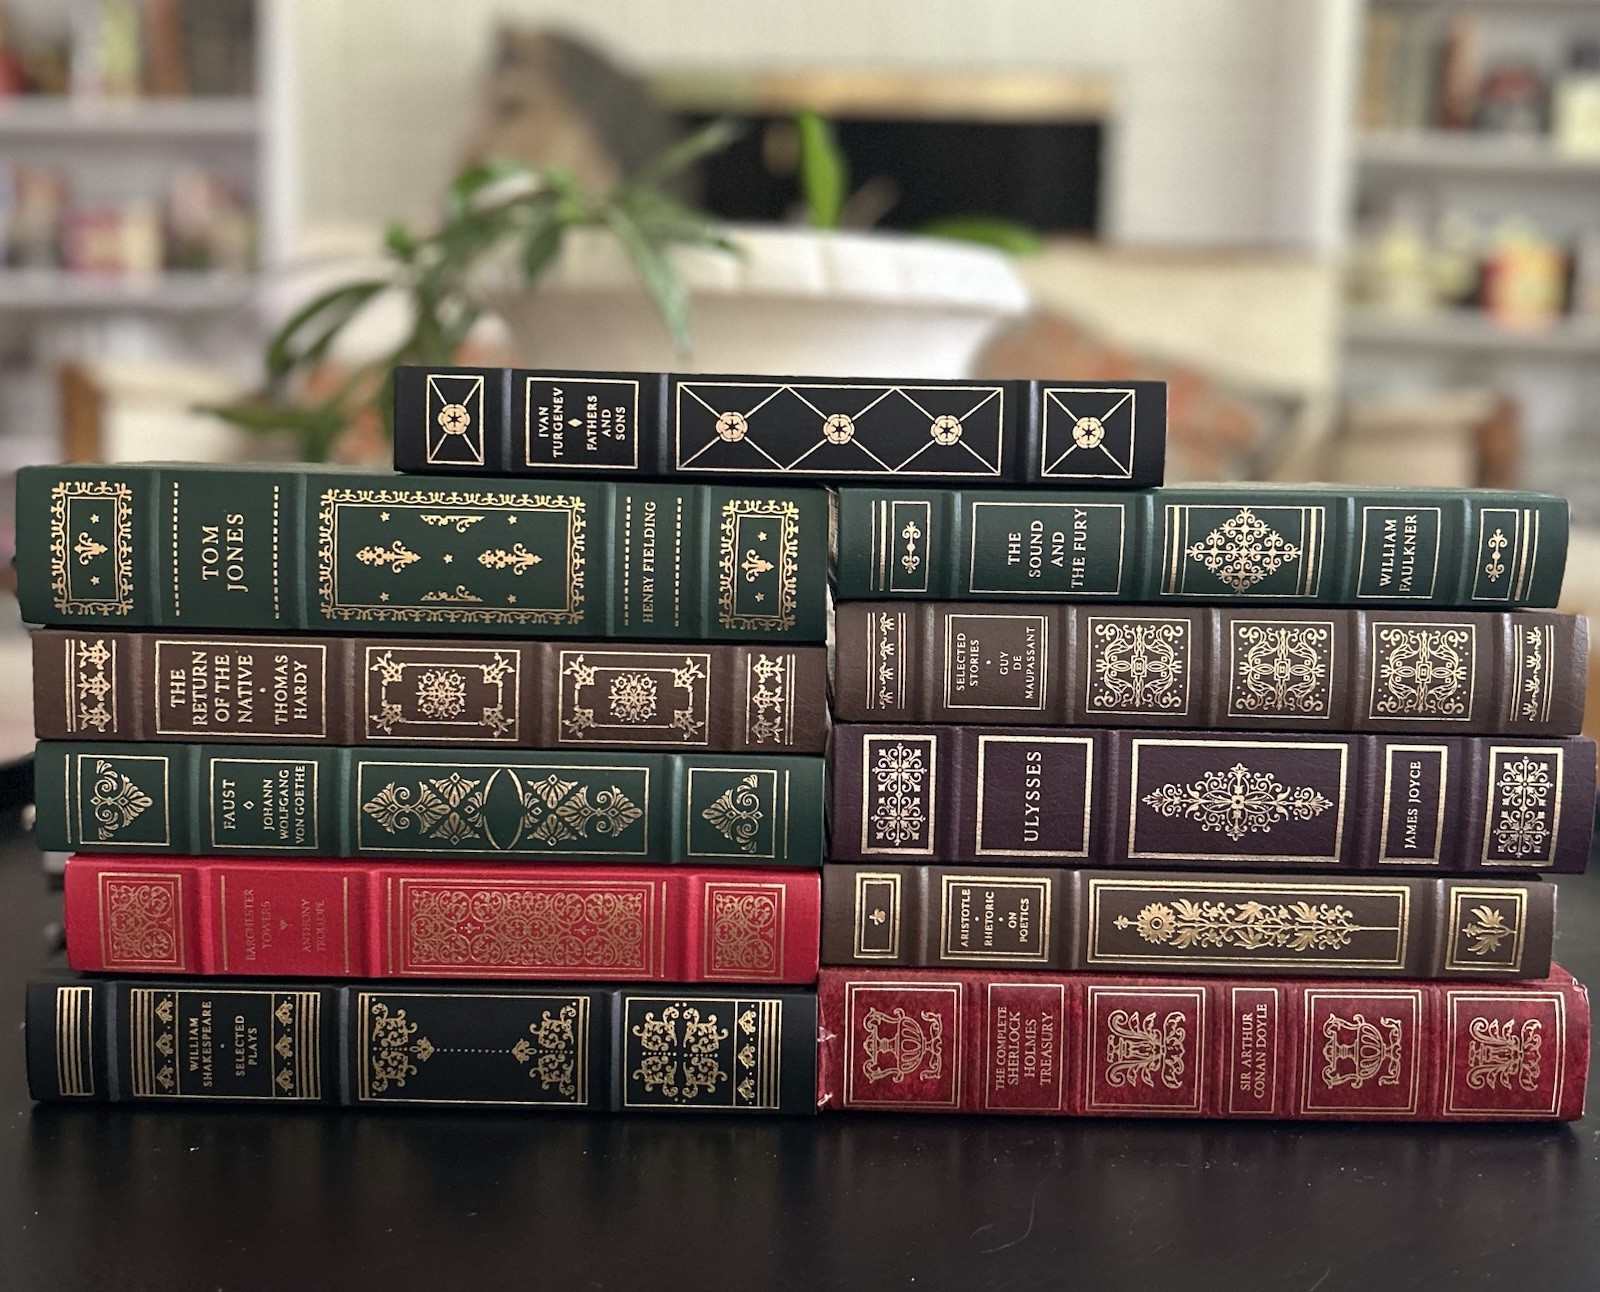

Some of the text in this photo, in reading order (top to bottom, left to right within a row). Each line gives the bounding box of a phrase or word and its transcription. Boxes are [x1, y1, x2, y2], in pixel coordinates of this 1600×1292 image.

[539, 406, 549, 438] IVAN
[553, 387, 563, 458] TURGENEV
[587, 395, 597, 451] FATHERS
[602, 409, 611, 437] AND
[615, 406, 626, 441] SONS
[202, 525, 219, 581] TOM
[227, 513, 249, 593] JONES
[642, 501, 656, 623] HENRY FIELDING
[1008, 532, 1022, 566] THE
[1029, 520, 1044, 578] SOUND
[1051, 531, 1065, 567] AND
[1071, 508, 1088, 589] THE FURY
[1380, 519, 1397, 586] WILLIAM
[1399, 515, 1417, 592] FAULKNER
[171, 669, 186, 708] THE
[192, 651, 208, 725] RETURN
[215, 655, 230, 722] OF THE
[237, 654, 253, 723] NATIVE
[275, 655, 289, 725] THOMAS
[294, 660, 308, 719] HARDY
[956, 633, 966, 691] SELECTED
[970, 640, 979, 686] STORIES
[1000, 651, 1009, 675] GUY
[1013, 655, 1022, 670] DE
[1026, 627, 1035, 699] MAUPASSANT
[223, 779, 236, 830] FAUST
[263, 779, 275, 831] JOHANN
[279, 770, 289, 839] WOLFGANG
[295, 765, 305, 844] VON GOETHE
[1024, 751, 1042, 842] ULYSSES
[1405, 761, 1422, 849] JAMES JOYCE
[261, 901, 272, 949] TOWERS
[302, 898, 311, 952] ANTHONY
[961, 889, 971, 947] ARISTOTLE
[984, 891, 994, 946] RHETORIC
[1008, 912, 1017, 929] ON
[1020, 898, 1030, 942] POETICS
[189, 1017, 199, 1071] WILLIAM
[202, 1001, 212, 1087] SHAKESPEARE
[235, 1015, 245, 1077] SELECTED
[248, 1027, 258, 1066] PLAYS
[996, 1006, 1007, 1090] THE COMPLETE
[1007, 1011, 1021, 1085] SHERLOCK
[1024, 1019, 1037, 1078] HOLMES
[1040, 1012, 1053, 1085] TREASURY
[1240, 1012, 1253, 1091] SIR ARTHUR
[1254, 1004, 1267, 1099] CONAN DOYLE
